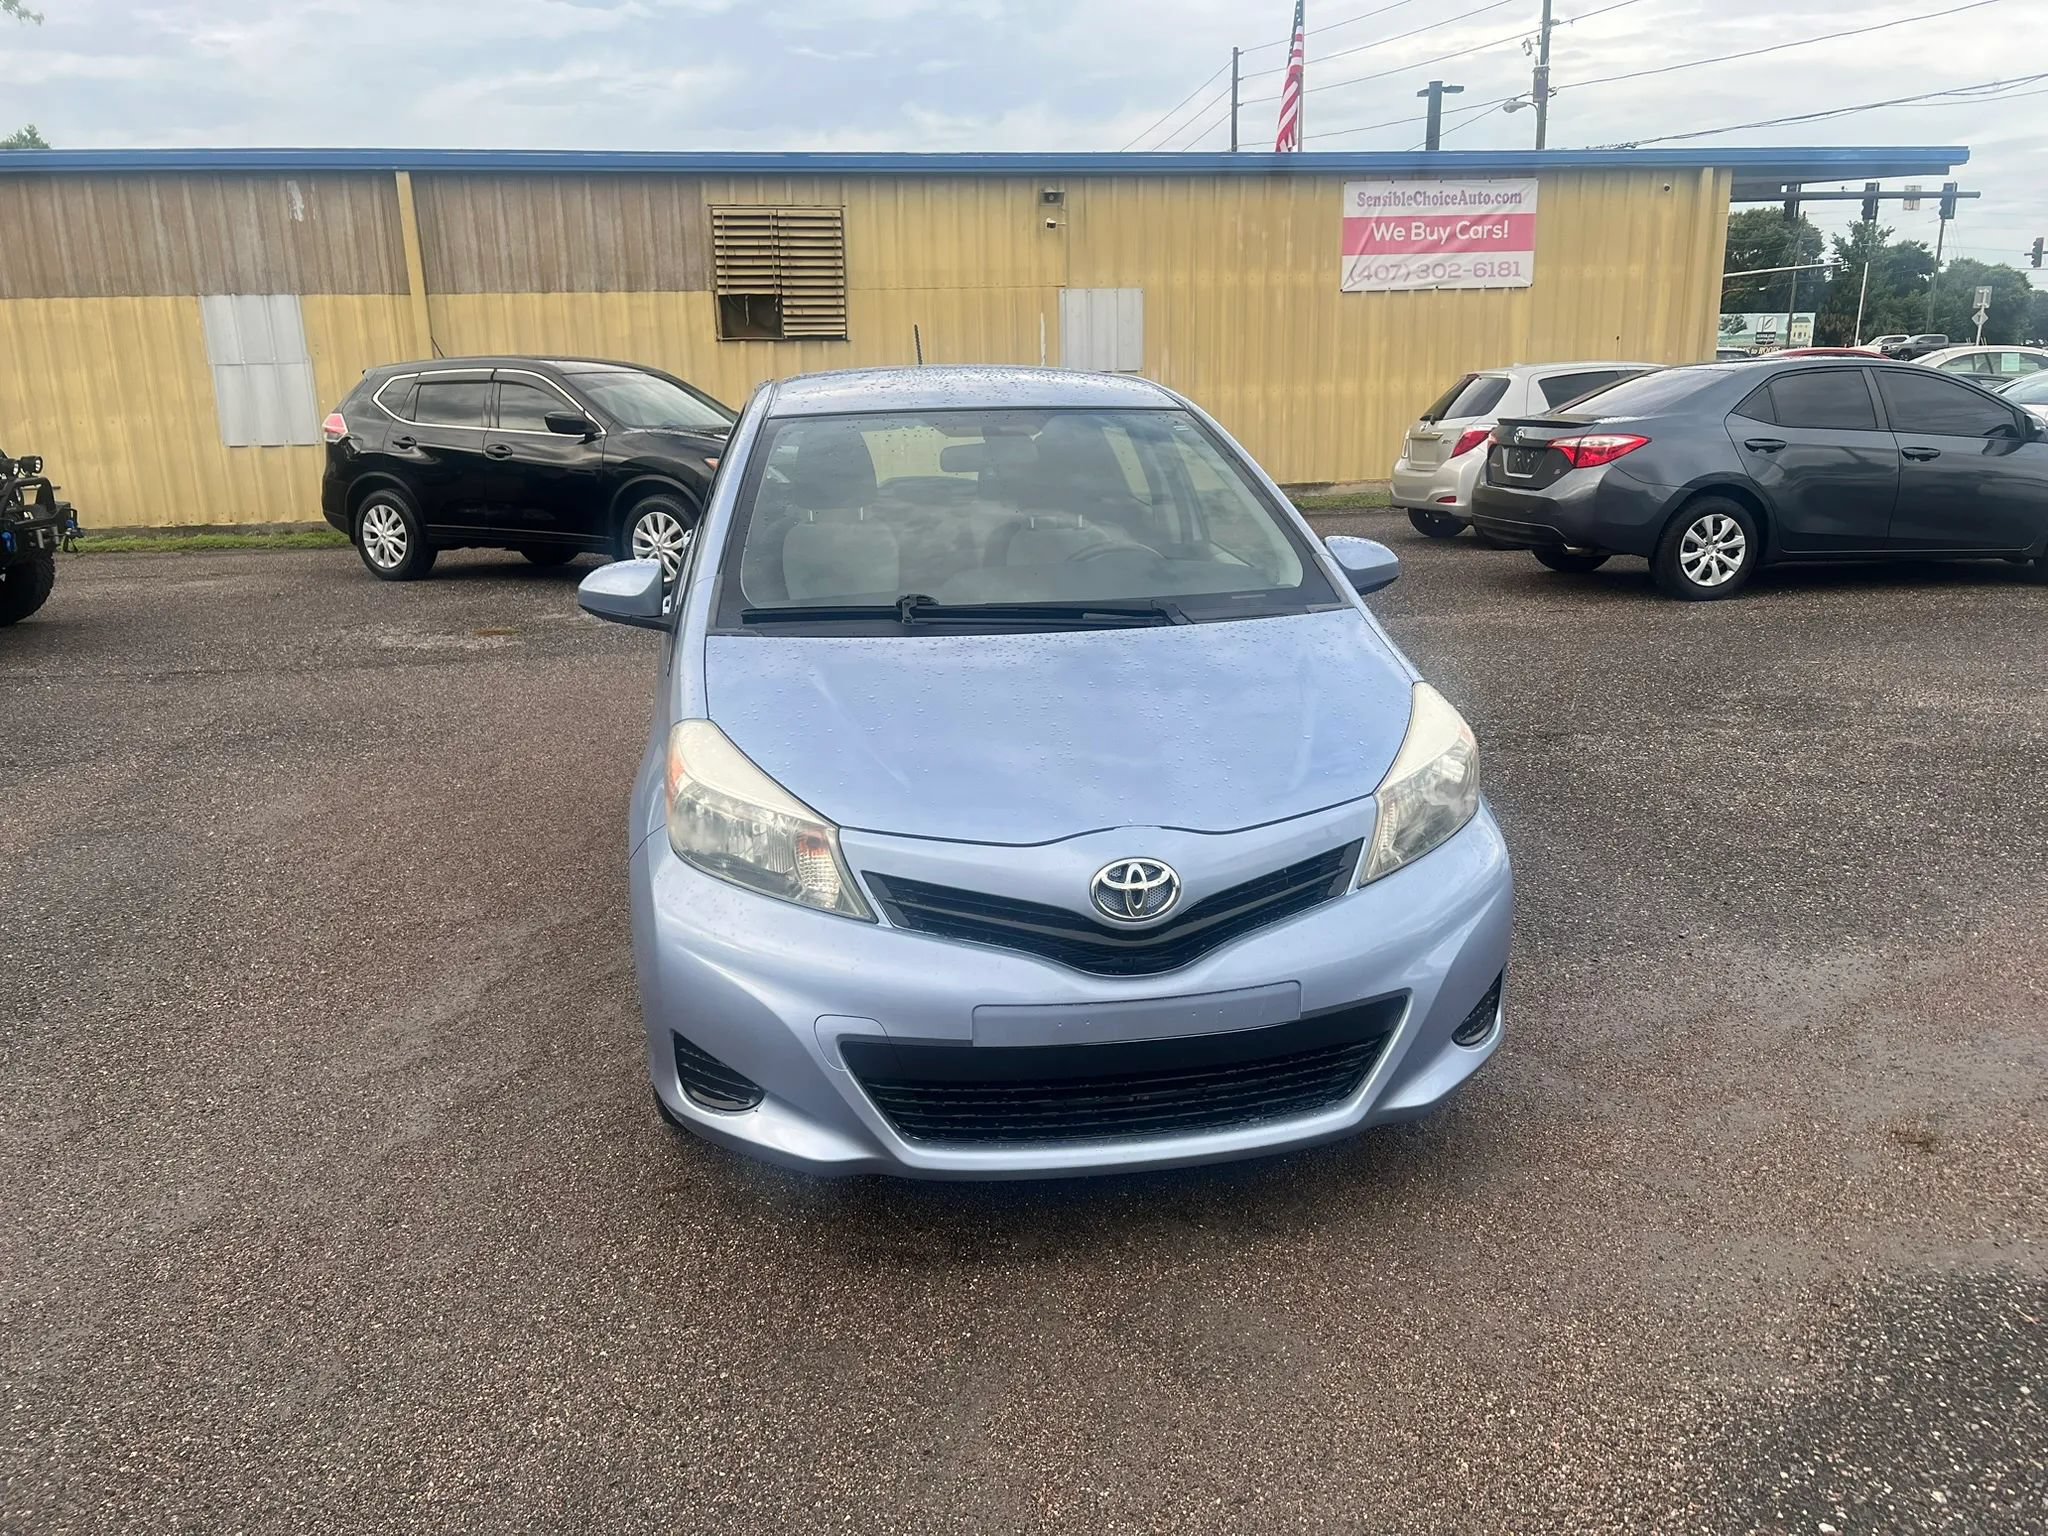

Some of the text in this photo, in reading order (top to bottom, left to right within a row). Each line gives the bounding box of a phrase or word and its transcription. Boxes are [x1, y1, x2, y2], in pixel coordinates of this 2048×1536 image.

[1357, 190, 1522, 207] SensibleChoiceAuto.com
[1372, 219, 1509, 245] We Buy Cars!
[1349, 260, 1521, 284] (407) 302-6181
